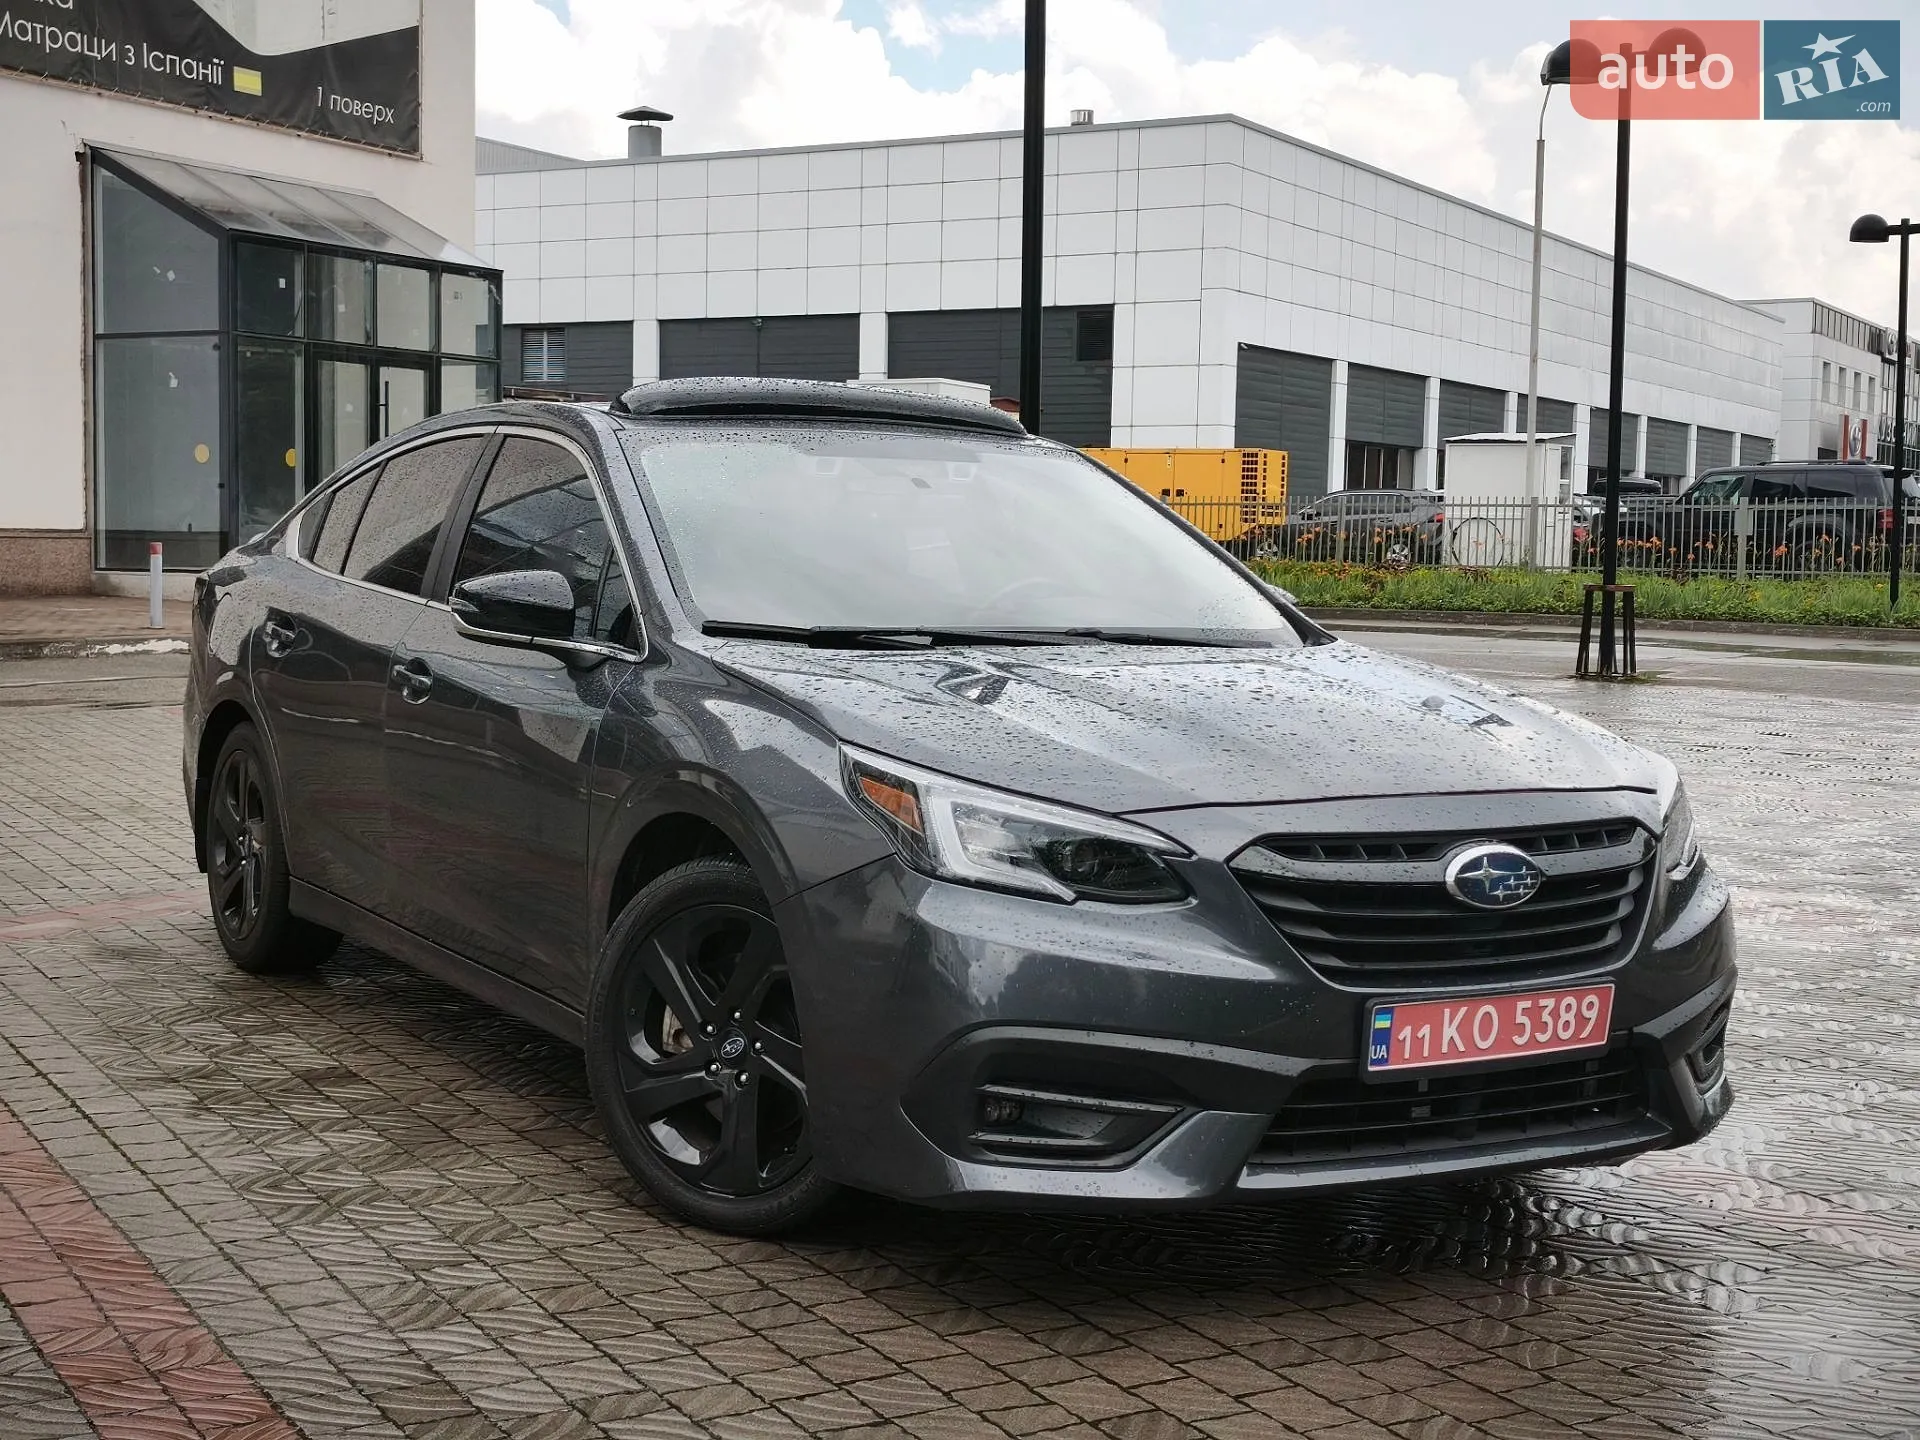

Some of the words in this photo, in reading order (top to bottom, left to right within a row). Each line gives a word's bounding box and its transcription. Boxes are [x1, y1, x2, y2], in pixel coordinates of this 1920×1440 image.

[124, 44, 135, 66] з
[143, 42, 224, 85] Іспанії
[317, 86, 323, 107] 1
[330, 93, 395, 125] поверх
[1511, 994, 1600, 1045] 5389
[1371, 1045, 1388, 1059] UA
